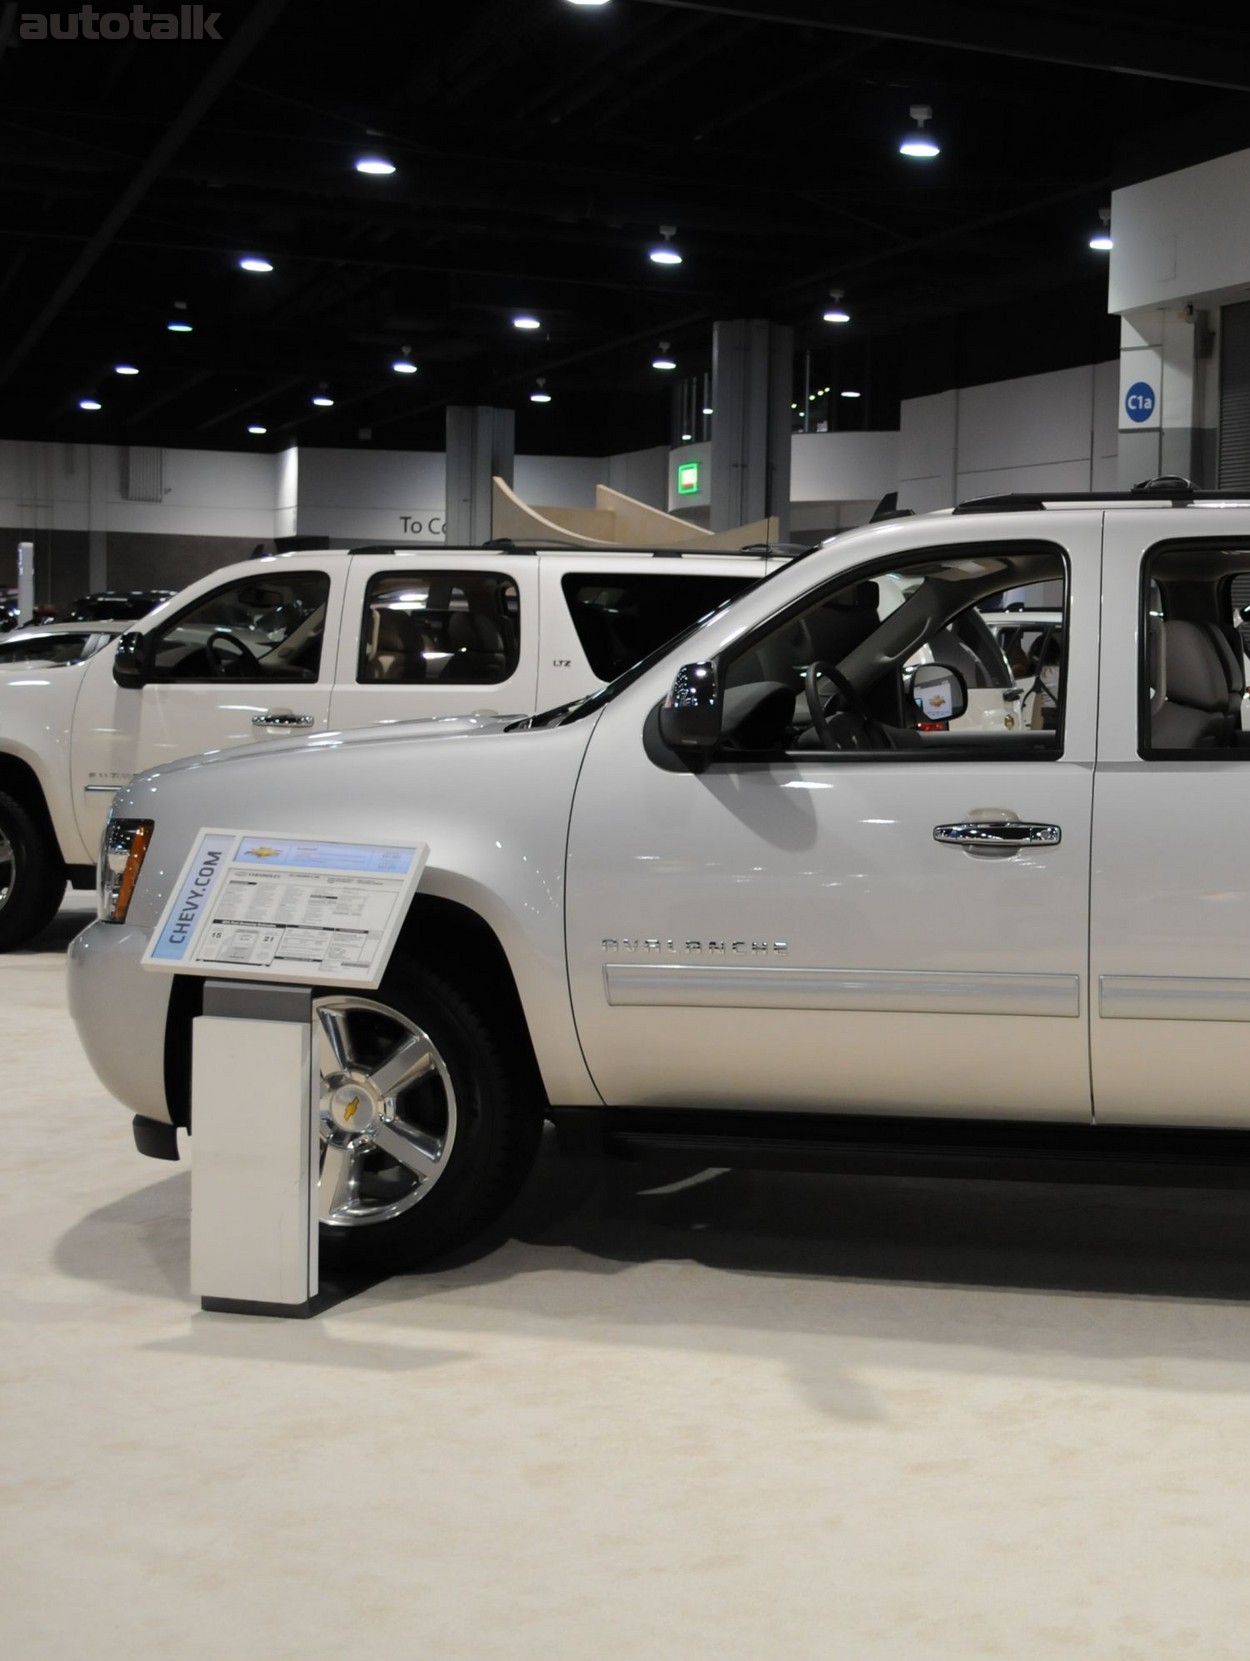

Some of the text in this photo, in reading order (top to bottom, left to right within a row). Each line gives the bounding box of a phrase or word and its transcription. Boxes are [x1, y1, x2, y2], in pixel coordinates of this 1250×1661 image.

[1127, 394, 1153, 410] C1a
[399, 516, 423, 534] To
[169, 850, 222, 945] CHEVY.COM
[602, 938, 788, 956] AVALANCHE
